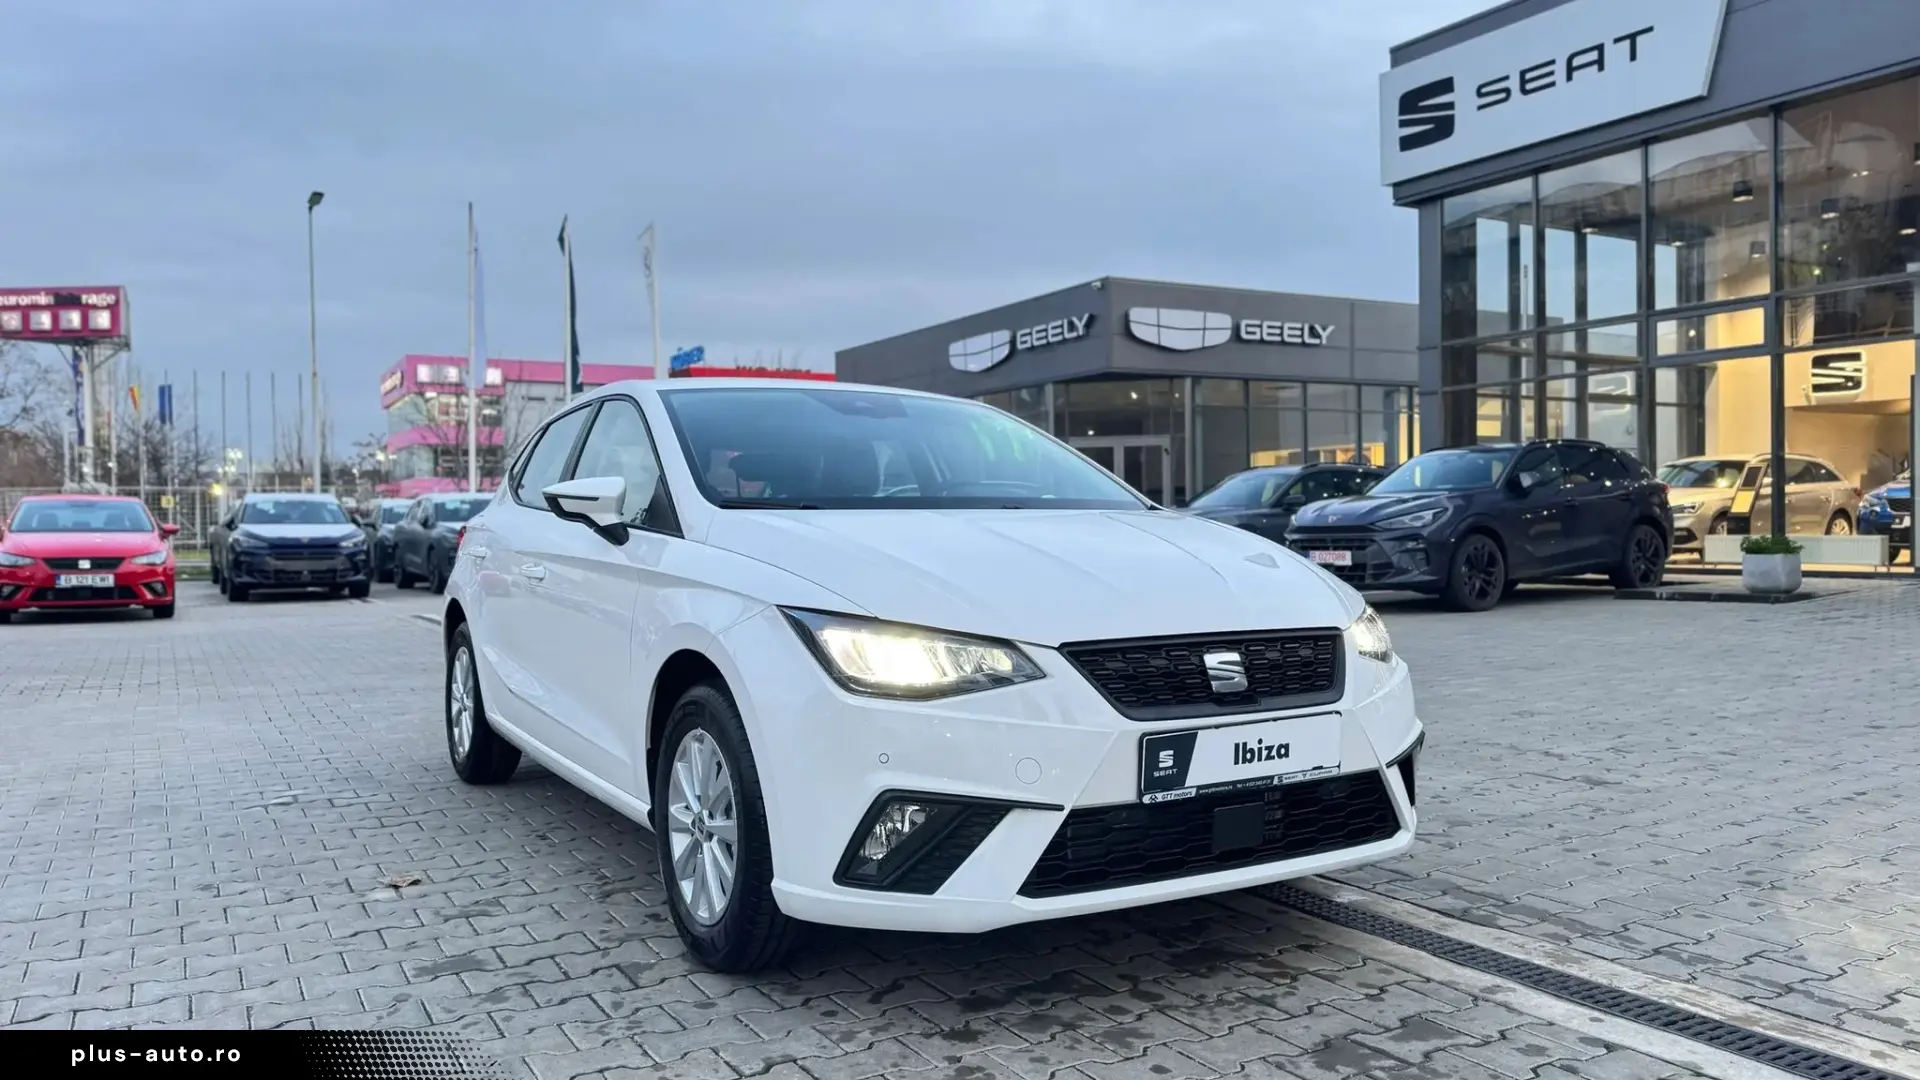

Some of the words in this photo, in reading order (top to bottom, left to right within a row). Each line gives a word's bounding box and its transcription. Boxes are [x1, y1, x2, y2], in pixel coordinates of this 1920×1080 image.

[1476, 25, 1654, 111] SEAT
[1016, 313, 1090, 350] GEELY
[1239, 319, 1335, 345] GEELY
[1233, 738, 1290, 766] Ibiza
[1153, 768, 1178, 777] SEAT
[1161, 793, 1174, 801] GTT
[1174, 790, 1193, 800] motors
